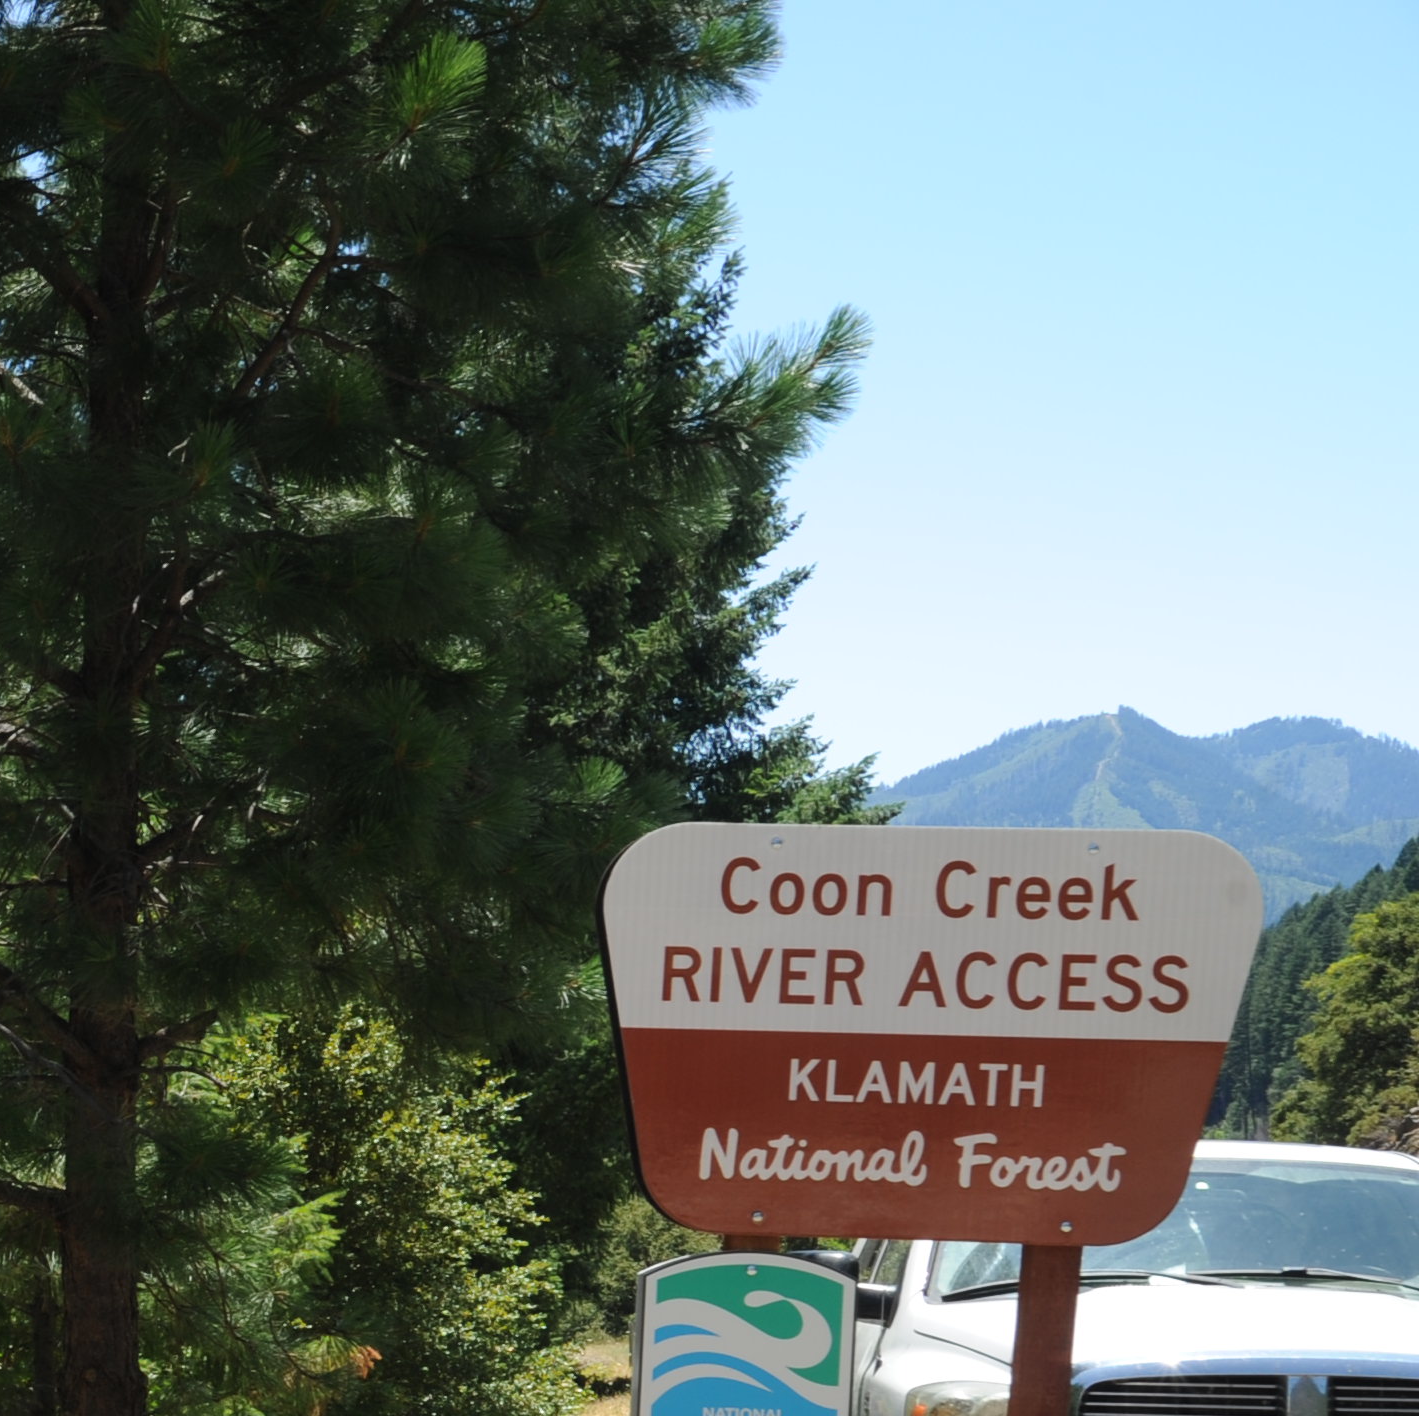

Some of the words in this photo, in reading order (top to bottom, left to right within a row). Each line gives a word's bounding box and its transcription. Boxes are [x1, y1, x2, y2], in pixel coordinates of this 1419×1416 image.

[720, 856, 894, 917] Coon
[935, 860, 1140, 922] Creek
[661, 946, 865, 1006] RIVER
[899, 951, 1190, 1014] ACCESS
[787, 1058, 1045, 1108] KLAMATH
[698, 1127, 928, 1187] National
[954, 1132, 1127, 1193] Forest
